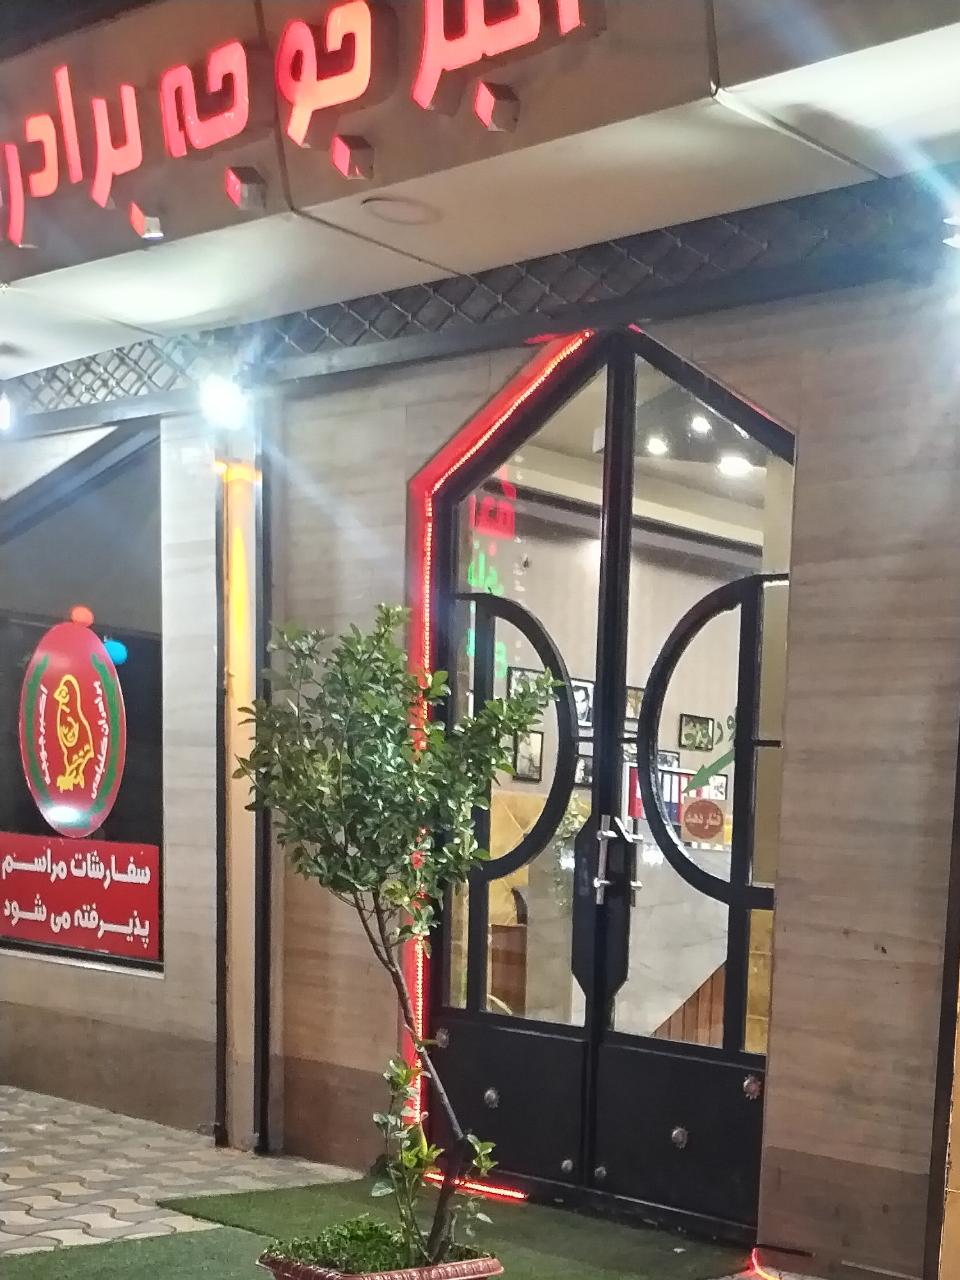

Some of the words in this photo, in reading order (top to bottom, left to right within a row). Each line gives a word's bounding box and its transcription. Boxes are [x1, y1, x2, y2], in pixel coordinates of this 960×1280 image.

[160, 0, 373, 207] جوجه
[0, 64, 148, 248] برادر
[2, 848, 68, 884] مراسم
[70, 850, 151, 890] سفارشات
[4, 893, 47, 927] شود
[50, 911, 71, 934] می
[74, 902, 150, 949] پذیرفته
